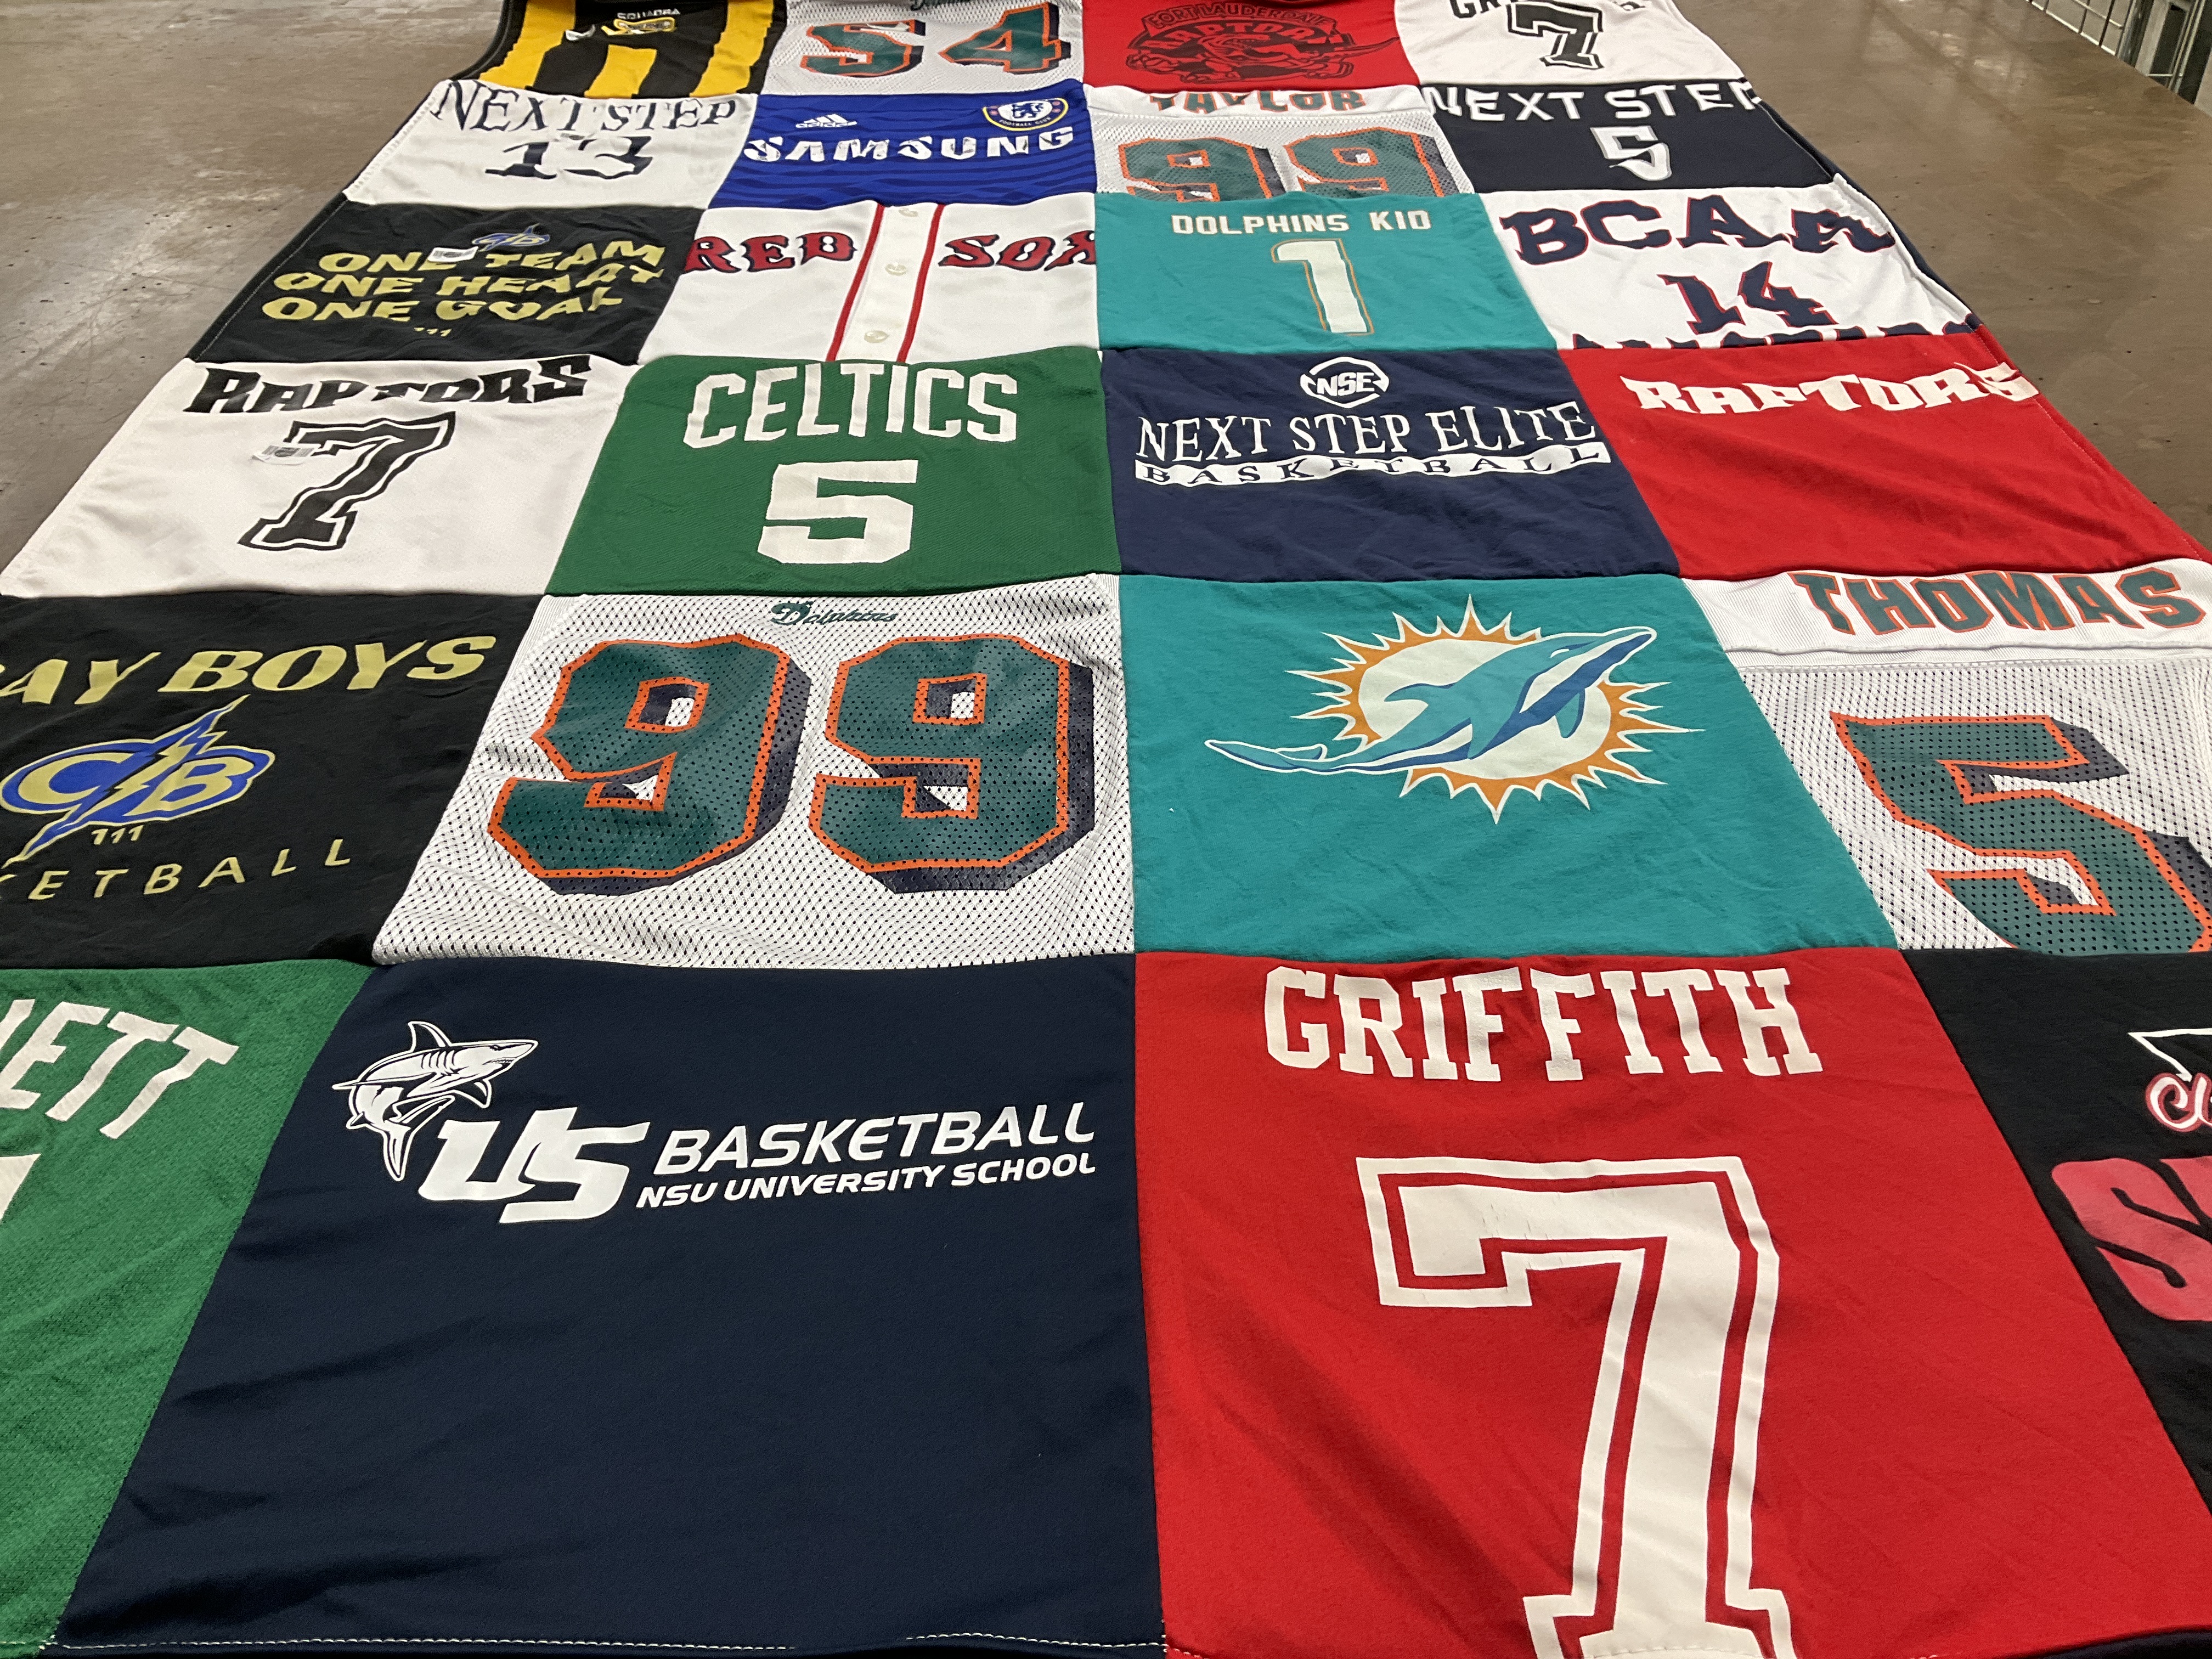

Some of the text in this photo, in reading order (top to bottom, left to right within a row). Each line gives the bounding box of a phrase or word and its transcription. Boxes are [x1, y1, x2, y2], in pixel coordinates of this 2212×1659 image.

[799, 3, 1071, 78] 54
[1506, 0, 1605, 70] 7
[430, 80, 737, 132] NEXT STEP
[1149, 89, 1367, 114] TAYLOR
[1420, 86, 1584, 121] NEXT
[485, 136, 653, 179] 13
[743, 126, 1073, 162] SAMSUNG
[1118, 127, 1460, 203] 99
[1590, 125, 1672, 181] 5
[1171, 210, 1432, 235] DOLPHINS KID
[485, 240, 665, 271] TEAM
[684, 231, 859, 273] RED
[262, 286, 623, 321] ONE GOAL
[273, 273, 424, 297] ONE
[1270, 238, 1375, 336] 1
[1657, 261, 1839, 335] 14
[182, 354, 592, 414] RAPTORS
[682, 363, 1018, 449] CELTICS
[1316, 372, 1375, 397] NSE
[1620, 362, 2040, 414] RAPTORS
[1135, 400, 1598, 462] NEXT STEP ELITE
[236, 411, 456, 551] 7
[1143, 445, 1602, 484] BASKETBALL
[757, 459, 919, 565] 5
[771, 601, 899, 626] Dolphins
[1788, 567, 2207, 636] THOMAS
[0, 636, 497, 705] AY BOYS
[487, 633, 1095, 895] 99
[1265, 966, 1823, 1082] GRIFFITH
[418, 1102, 1095, 1223] US BASKETBALL
[636, 1153, 1096, 1208] NSU UNIVERSITY SCHOOL
[1355, 1155, 1797, 1659] 7
